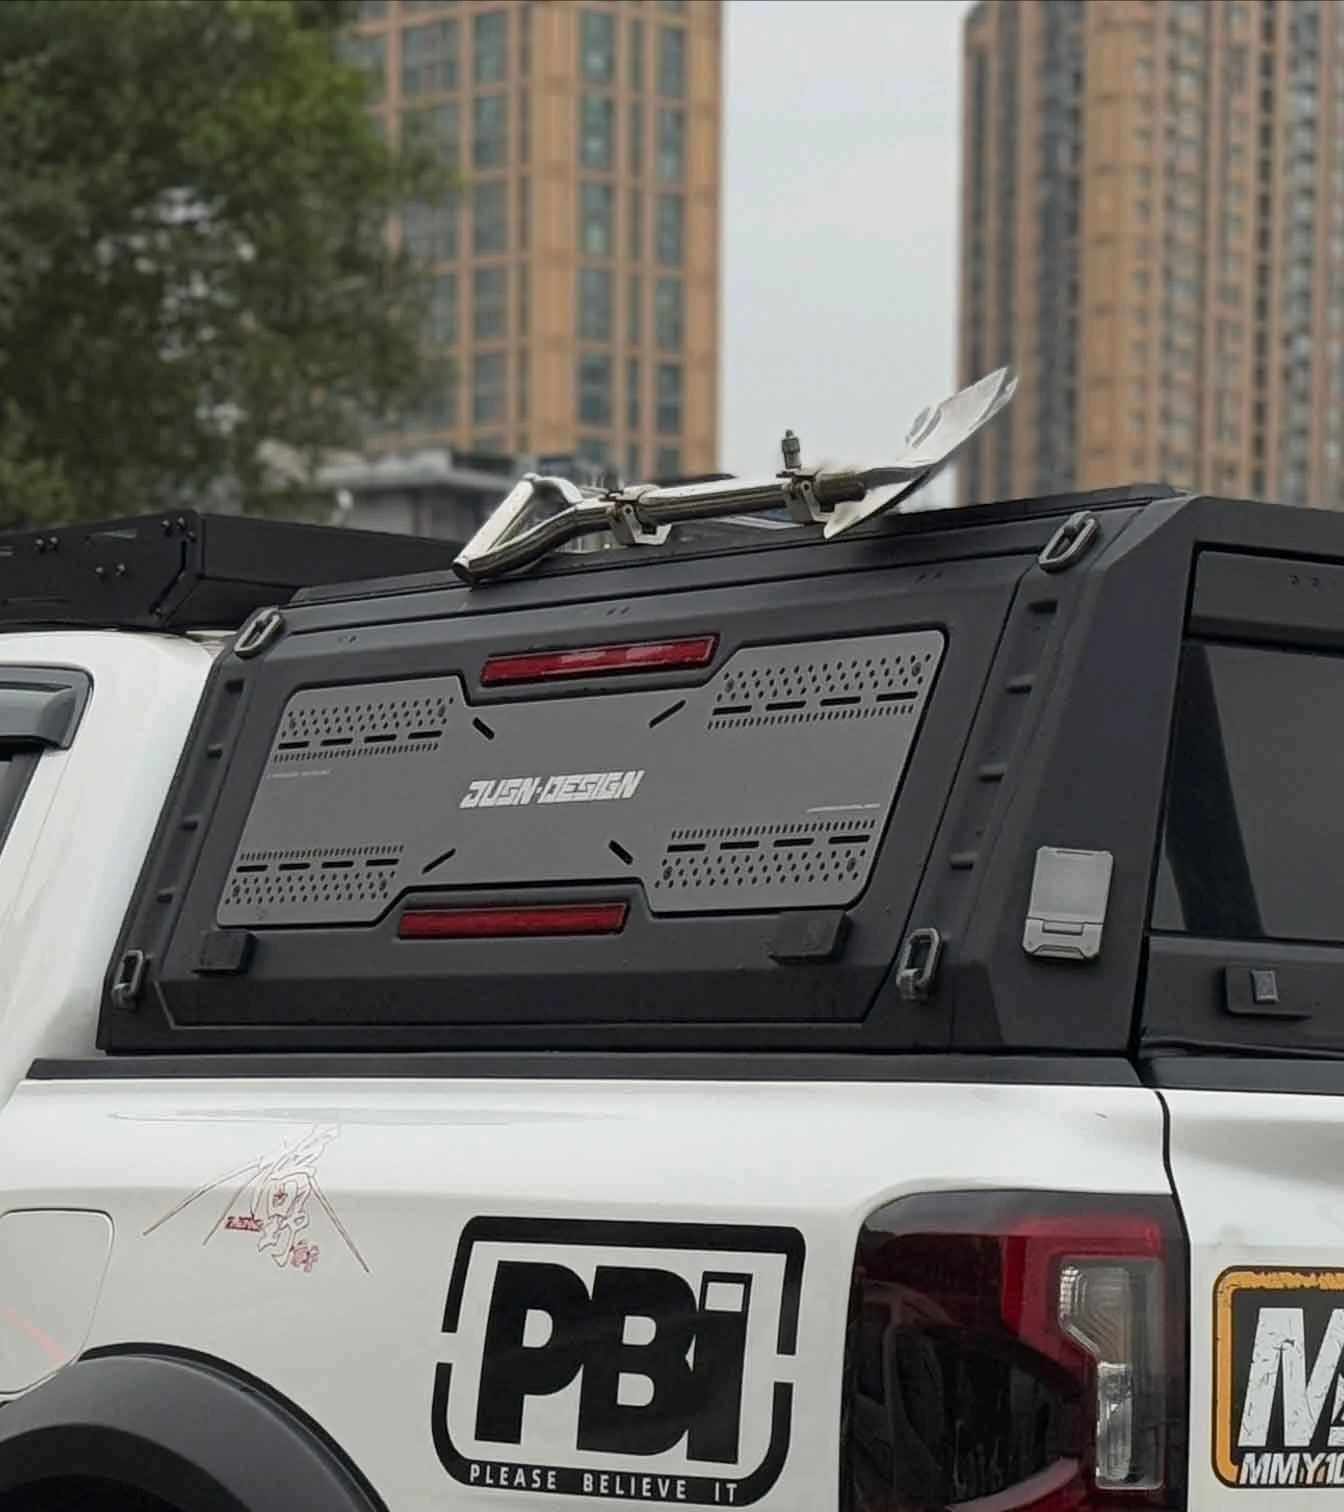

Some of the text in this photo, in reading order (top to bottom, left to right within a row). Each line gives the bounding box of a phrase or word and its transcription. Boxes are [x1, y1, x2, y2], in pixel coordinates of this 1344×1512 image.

[469, 1463, 738, 1504] PLEASE BELIEVE IT
